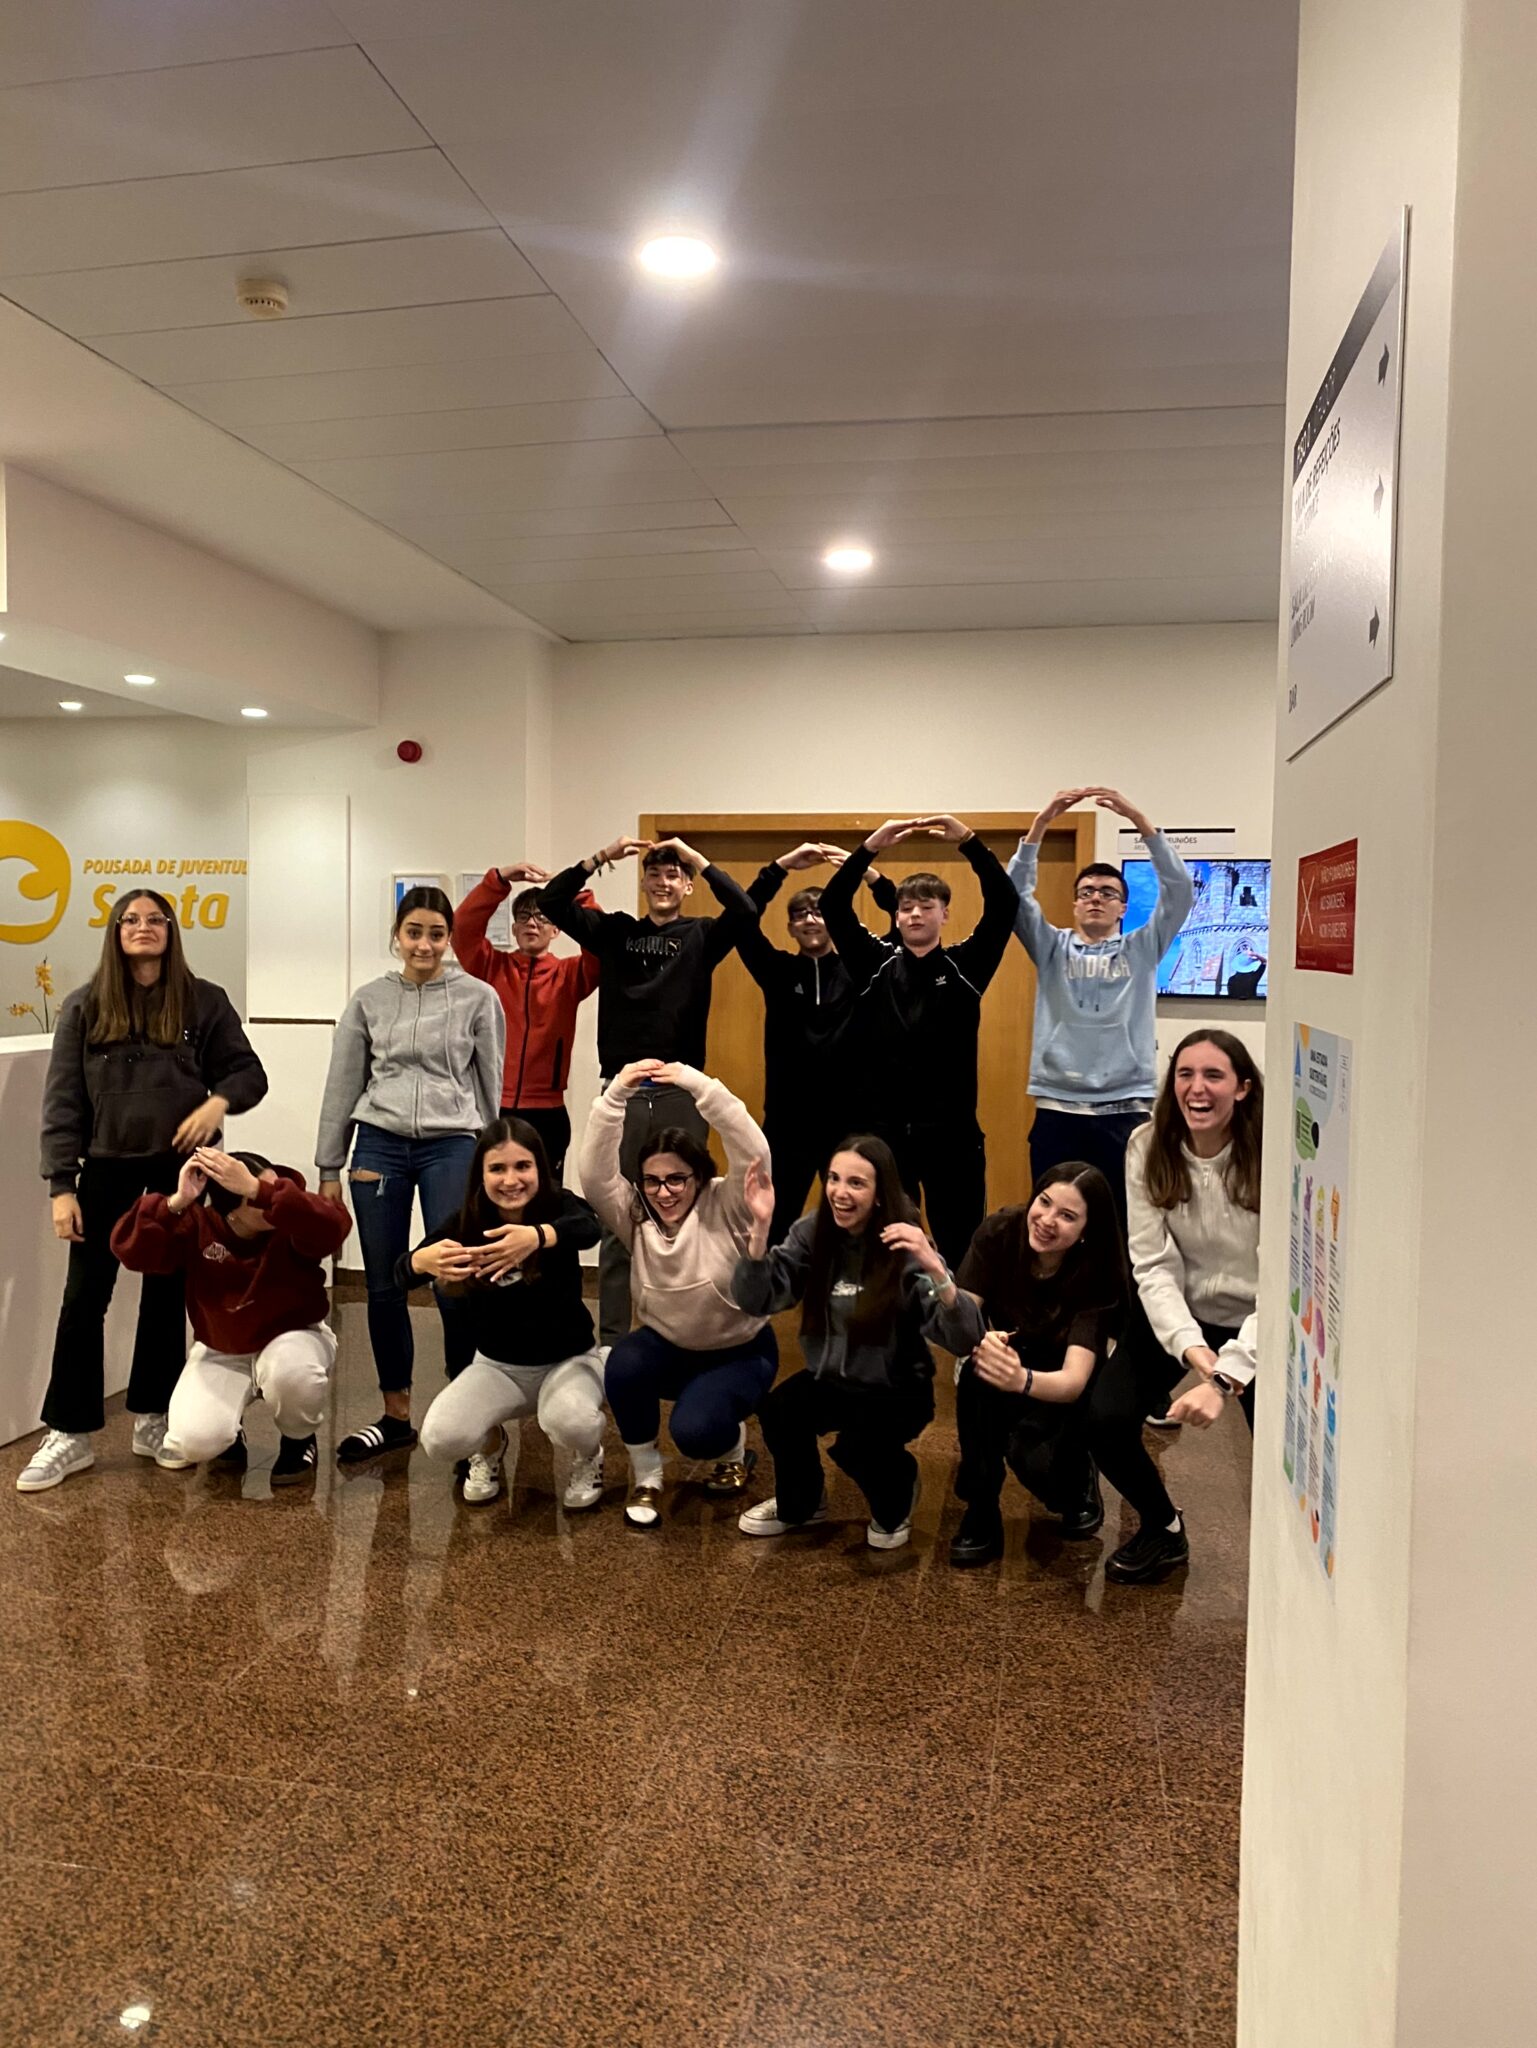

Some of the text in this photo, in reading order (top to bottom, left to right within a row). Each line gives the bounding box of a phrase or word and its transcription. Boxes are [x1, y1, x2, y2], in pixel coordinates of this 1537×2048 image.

[1166, 836, 1198, 844] EUNIÕES
[83, 859, 152, 874] POUSADA
[156, 859, 178, 874] DE
[87, 882, 230, 930] Sta
